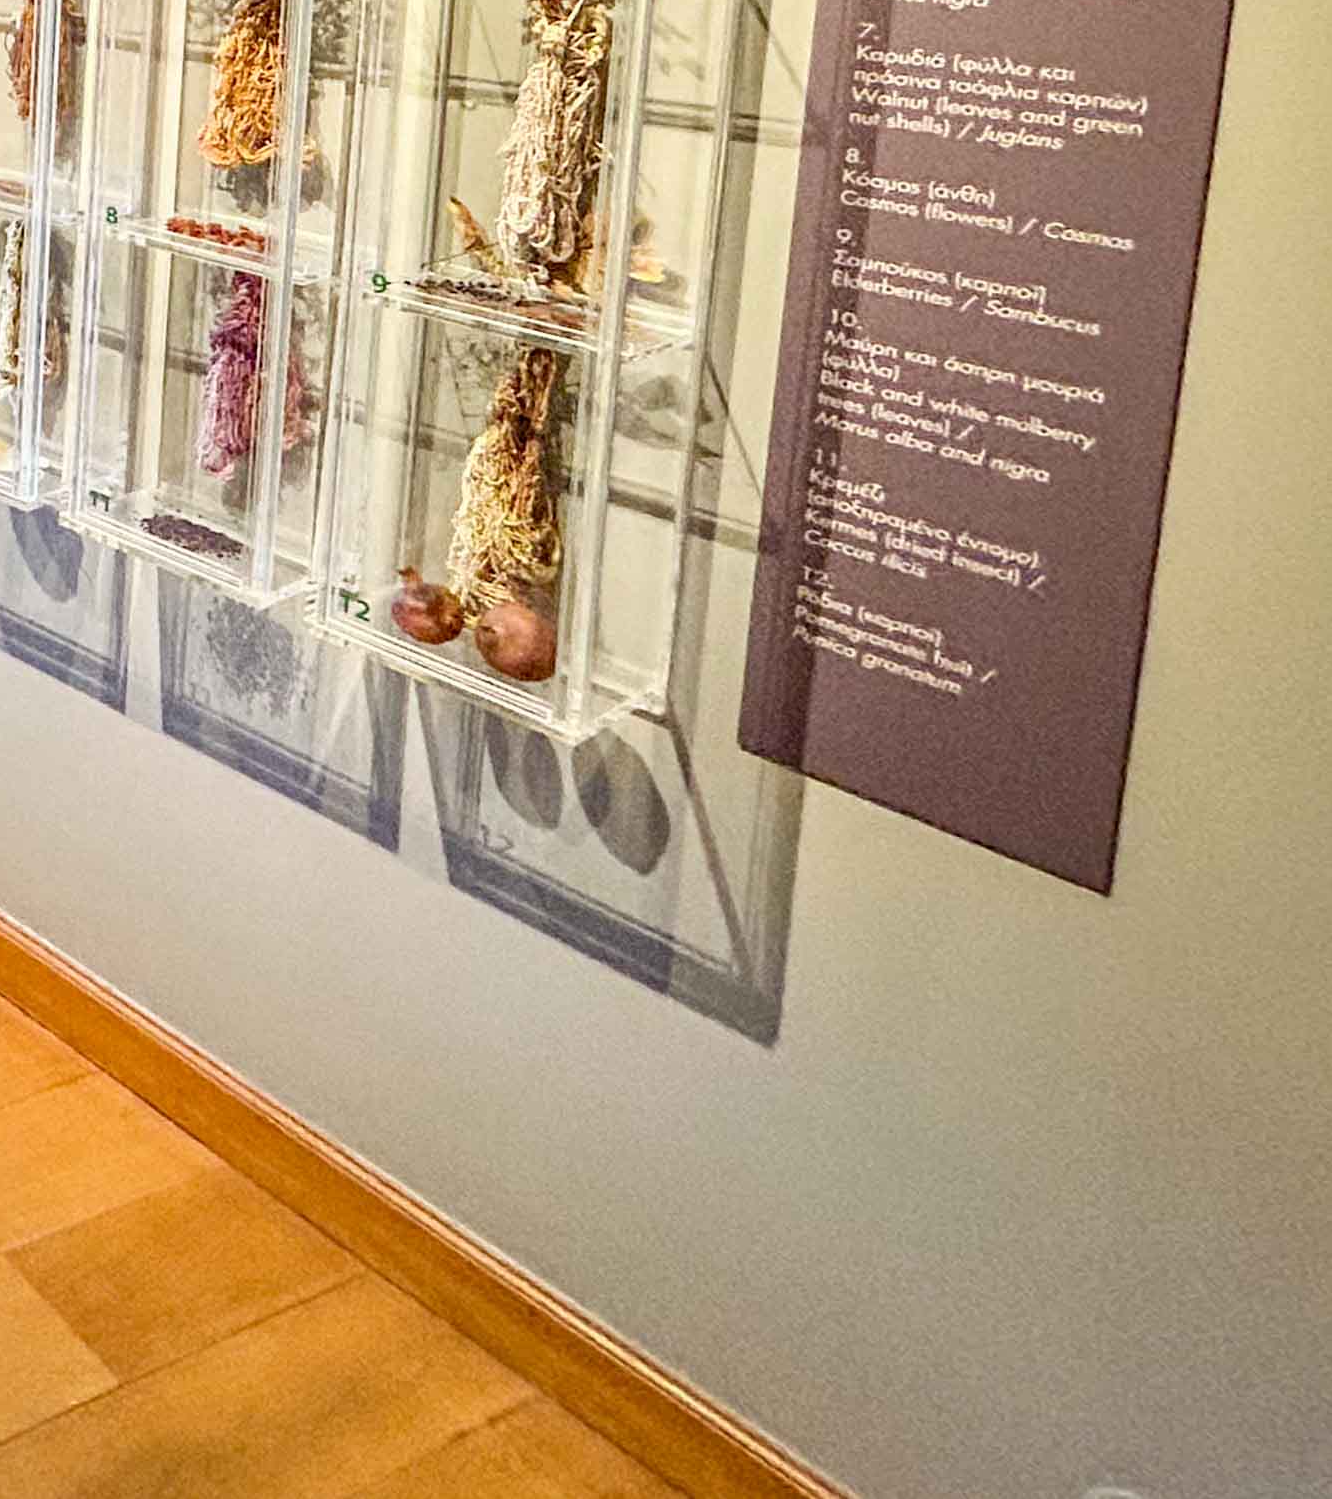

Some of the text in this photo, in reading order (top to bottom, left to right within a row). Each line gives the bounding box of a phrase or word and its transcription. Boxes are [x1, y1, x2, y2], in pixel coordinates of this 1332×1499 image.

[859, 22, 879, 40] 7.
[852, 86, 1143, 137] Walnut (leaves and green
[849, 112, 880, 126] nut
[887, 112, 950, 138] shells)
[976, 125, 1064, 150] Juglans
[845, 148, 864, 164] 8.
[106, 205, 118, 224] 8
[841, 190, 919, 217] Cosmos
[925, 202, 1013, 234] (flowers)
[1044, 221, 1135, 251] Cosmos
[837, 228, 855, 246] 9.
[372, 273, 388, 294] 9
[832, 269, 953, 307] Elderberries
[984, 300, 1100, 336] Sambucus
[832, 308, 862, 330] 10.
[818, 392, 865, 415] trees
[872, 403, 950, 437] (leaves)
[821, 370, 1096, 449] Black and white mulberry
[815, 412, 1050, 483] Morus alba and nigra
[816, 448, 847, 472] 11.
[886, 532, 946, 562] (dried
[952, 551, 1020, 585] insect)
